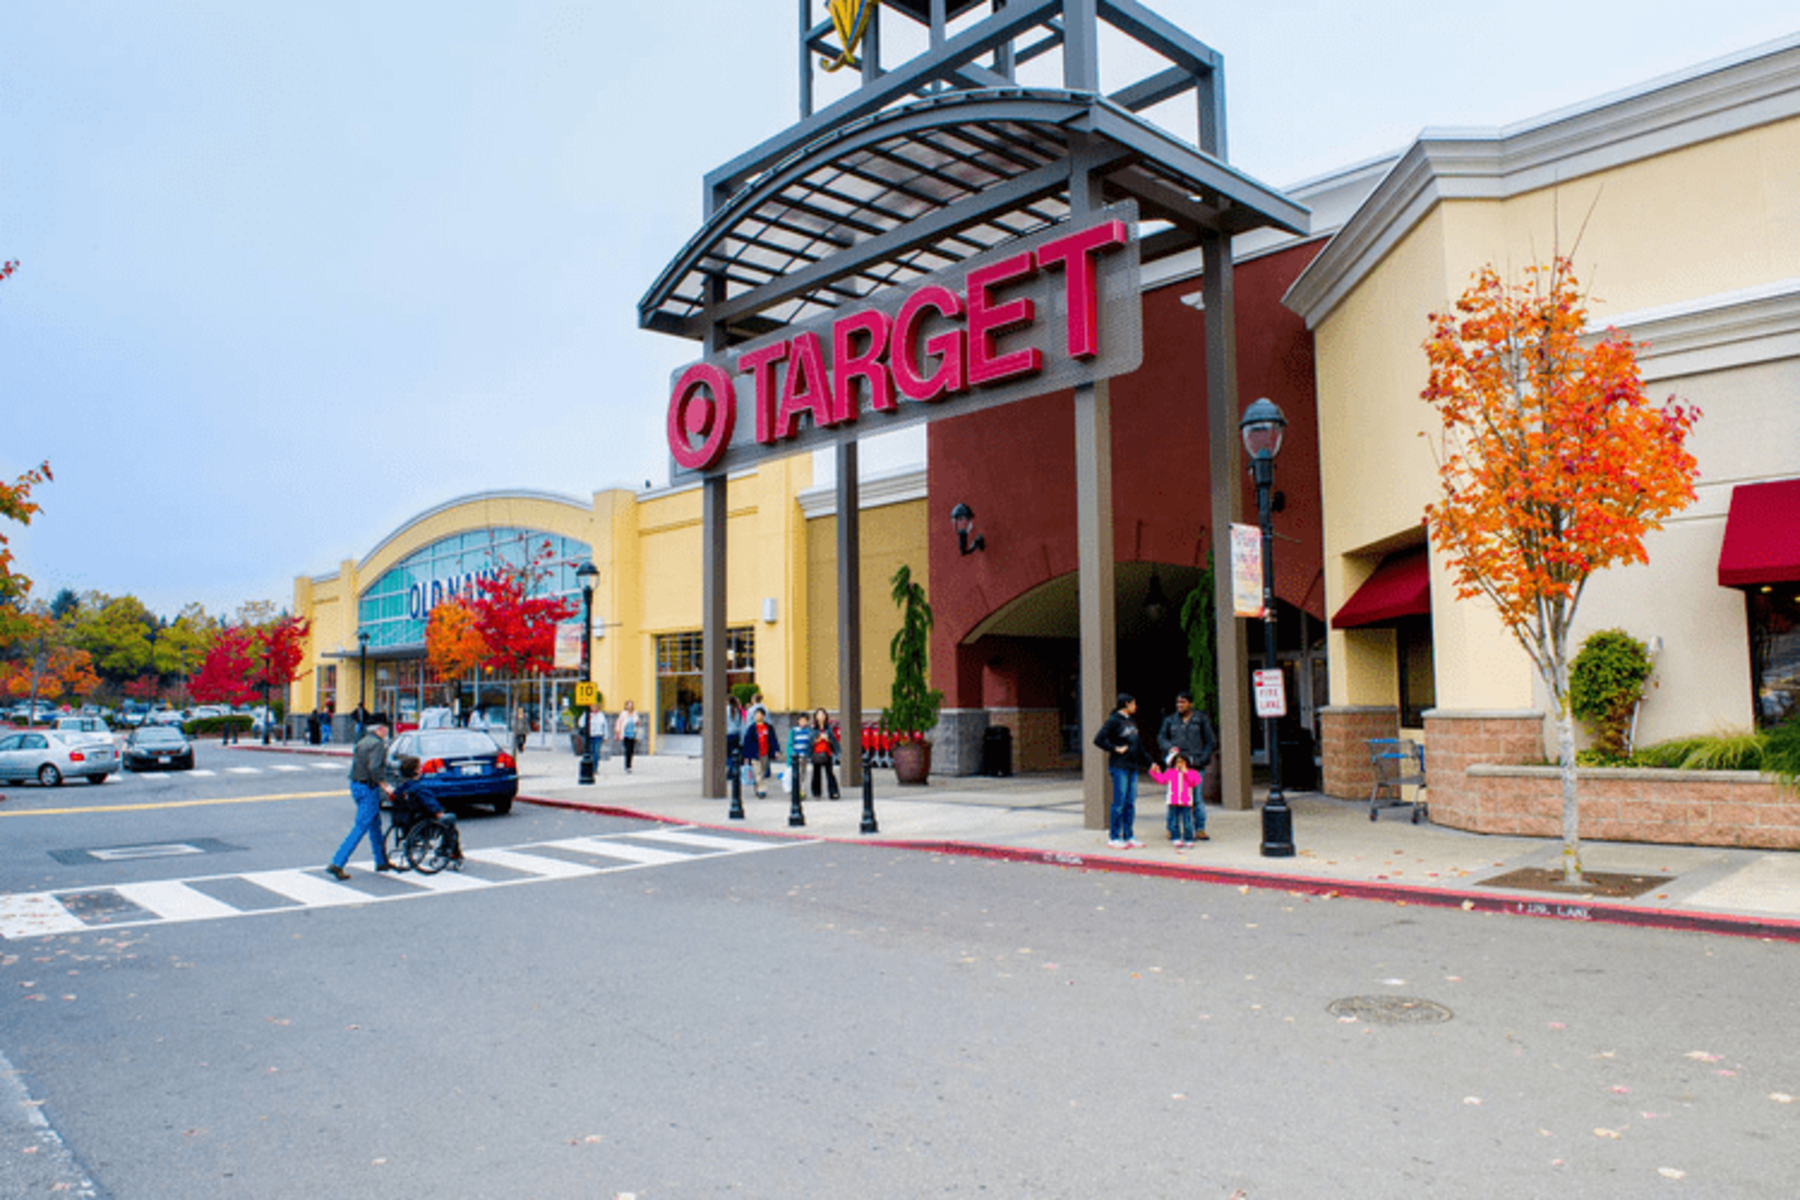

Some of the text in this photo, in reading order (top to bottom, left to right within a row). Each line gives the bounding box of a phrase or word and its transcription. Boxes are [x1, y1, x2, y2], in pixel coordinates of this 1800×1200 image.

[737, 218, 1127, 445] TARGET
[410, 579, 443, 620] OLD
[580, 685, 594, 697] 10
